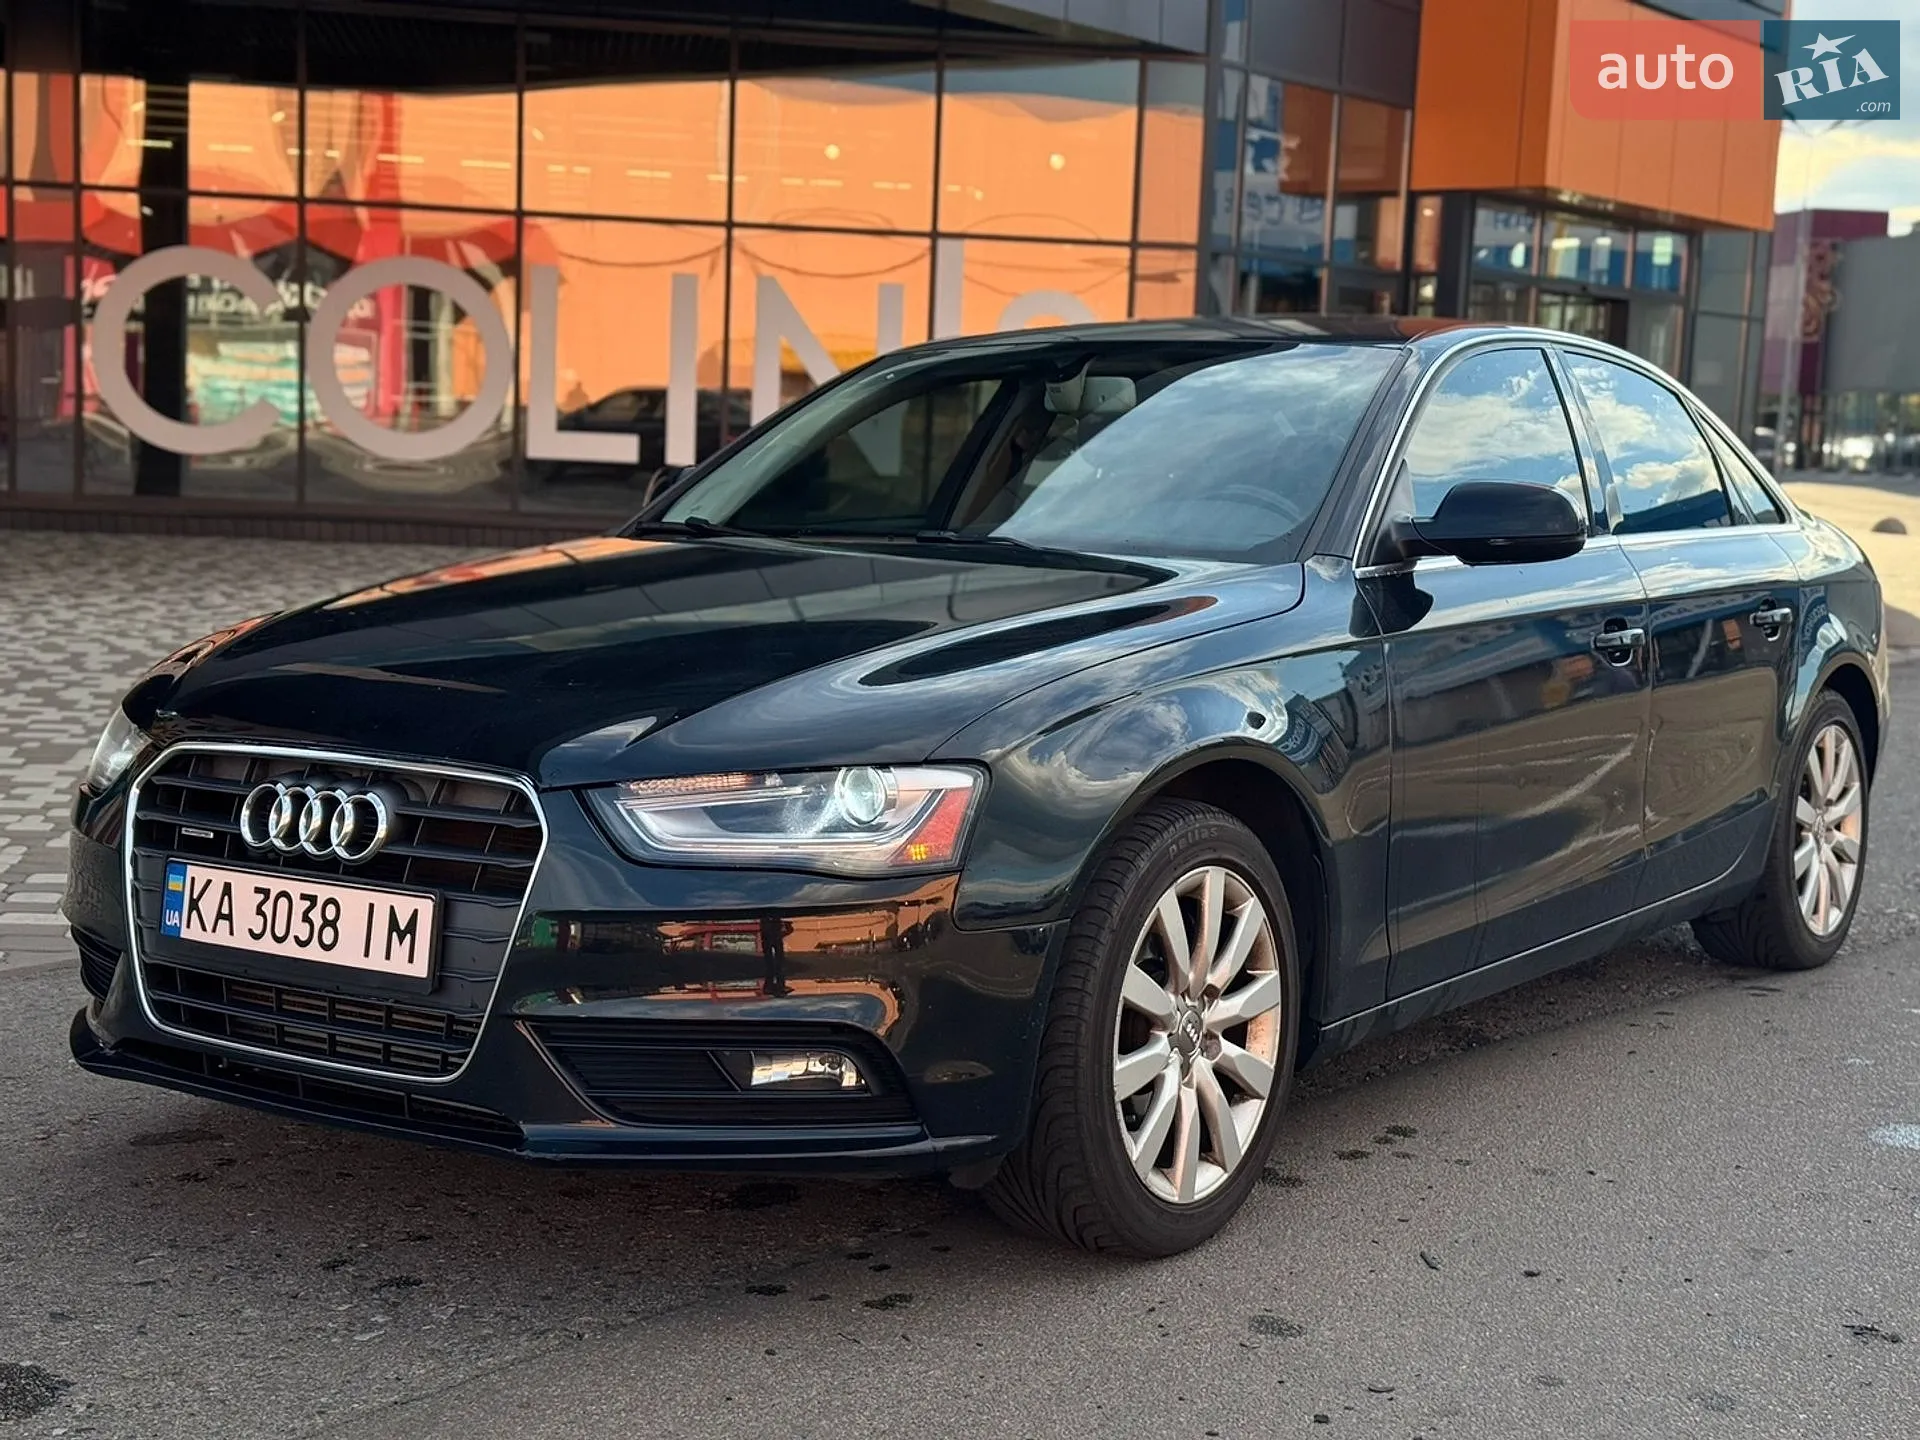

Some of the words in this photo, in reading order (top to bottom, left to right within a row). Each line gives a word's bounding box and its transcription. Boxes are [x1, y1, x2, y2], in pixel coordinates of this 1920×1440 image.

[165, 909, 180, 928] UA
[186, 876, 235, 937] KA
[248, 886, 341, 951] 3038
[363, 902, 419, 964] IM
